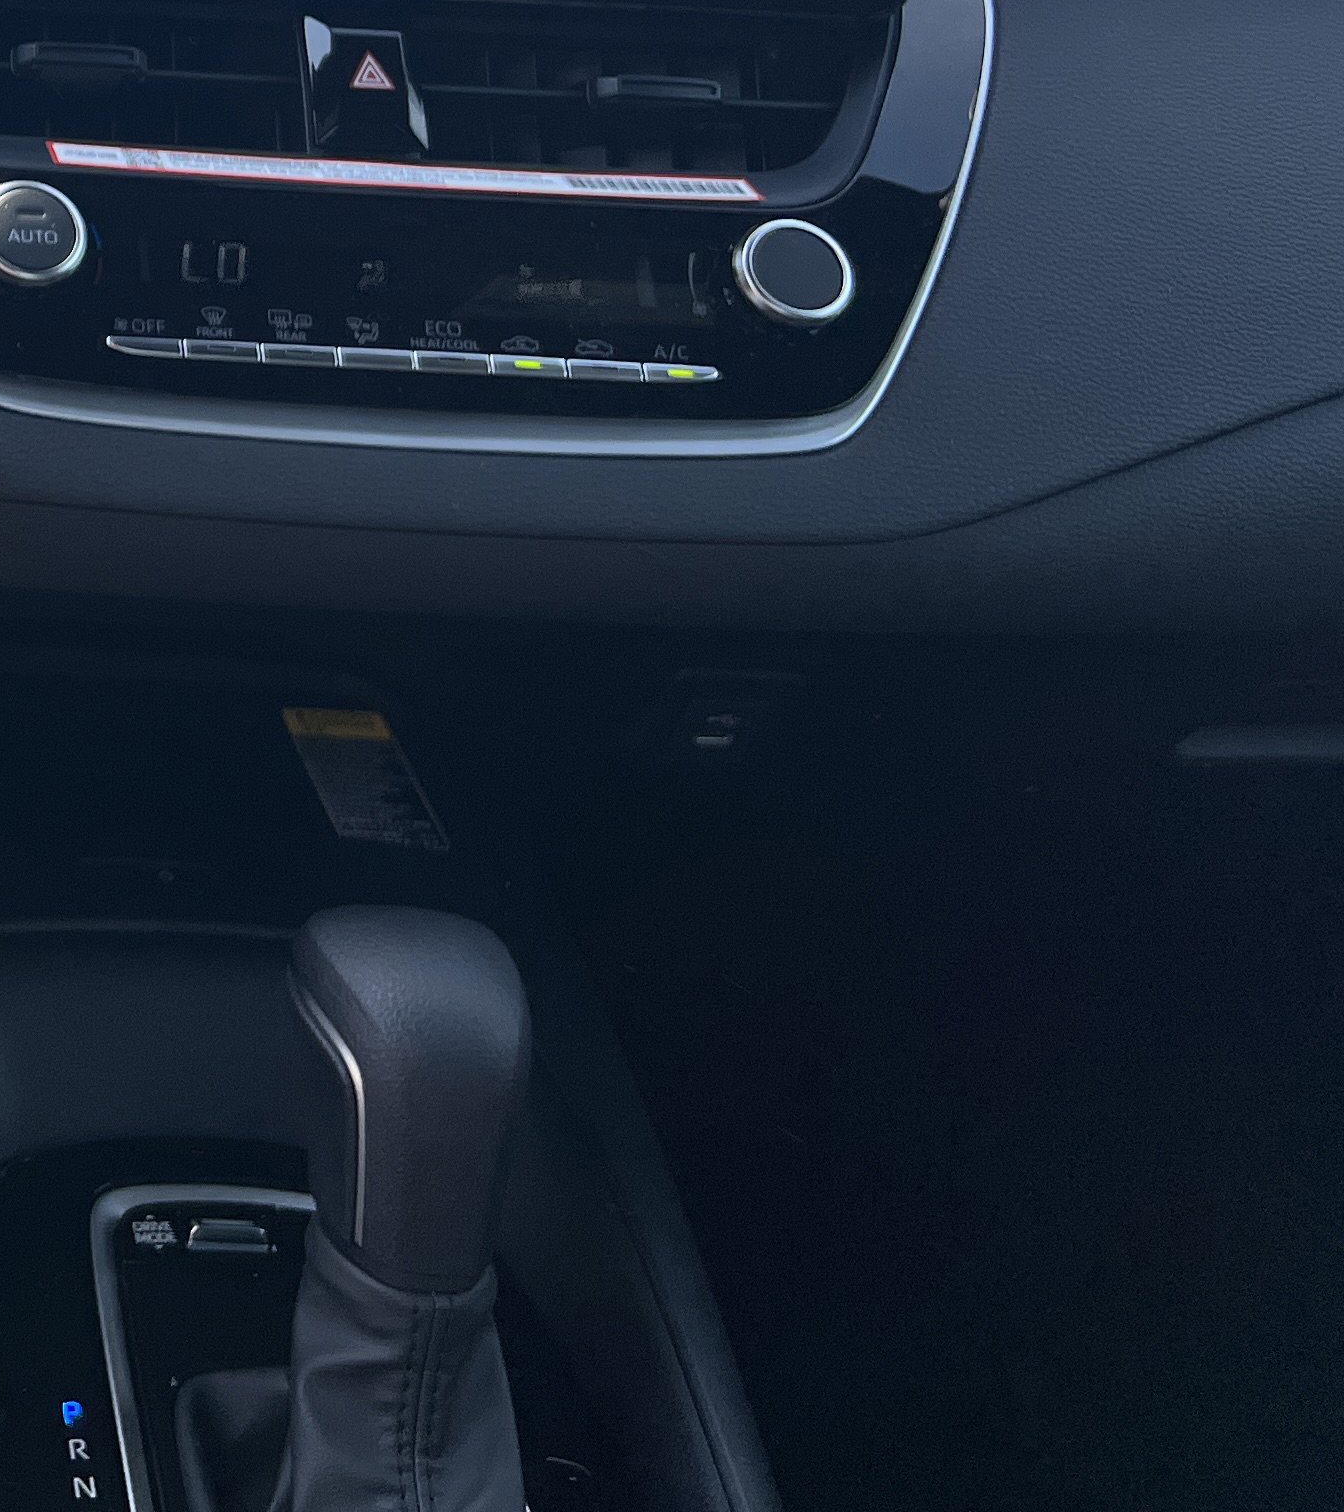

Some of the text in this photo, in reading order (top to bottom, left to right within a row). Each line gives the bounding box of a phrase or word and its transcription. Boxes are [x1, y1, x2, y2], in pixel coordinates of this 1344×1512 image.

[7, 228, 59, 245] AUTO
[131, 317, 165, 334] OFF
[195, 325, 233, 338] FRONT
[424, 320, 461, 337] ECO
[275, 330, 308, 342] REAR
[410, 337, 480, 351] HEAT/COOL
[653, 344, 689, 361] A/C
[62, 1400, 83, 1426] P
[68, 1438, 91, 1460] R
[73, 1476, 97, 1499] N
